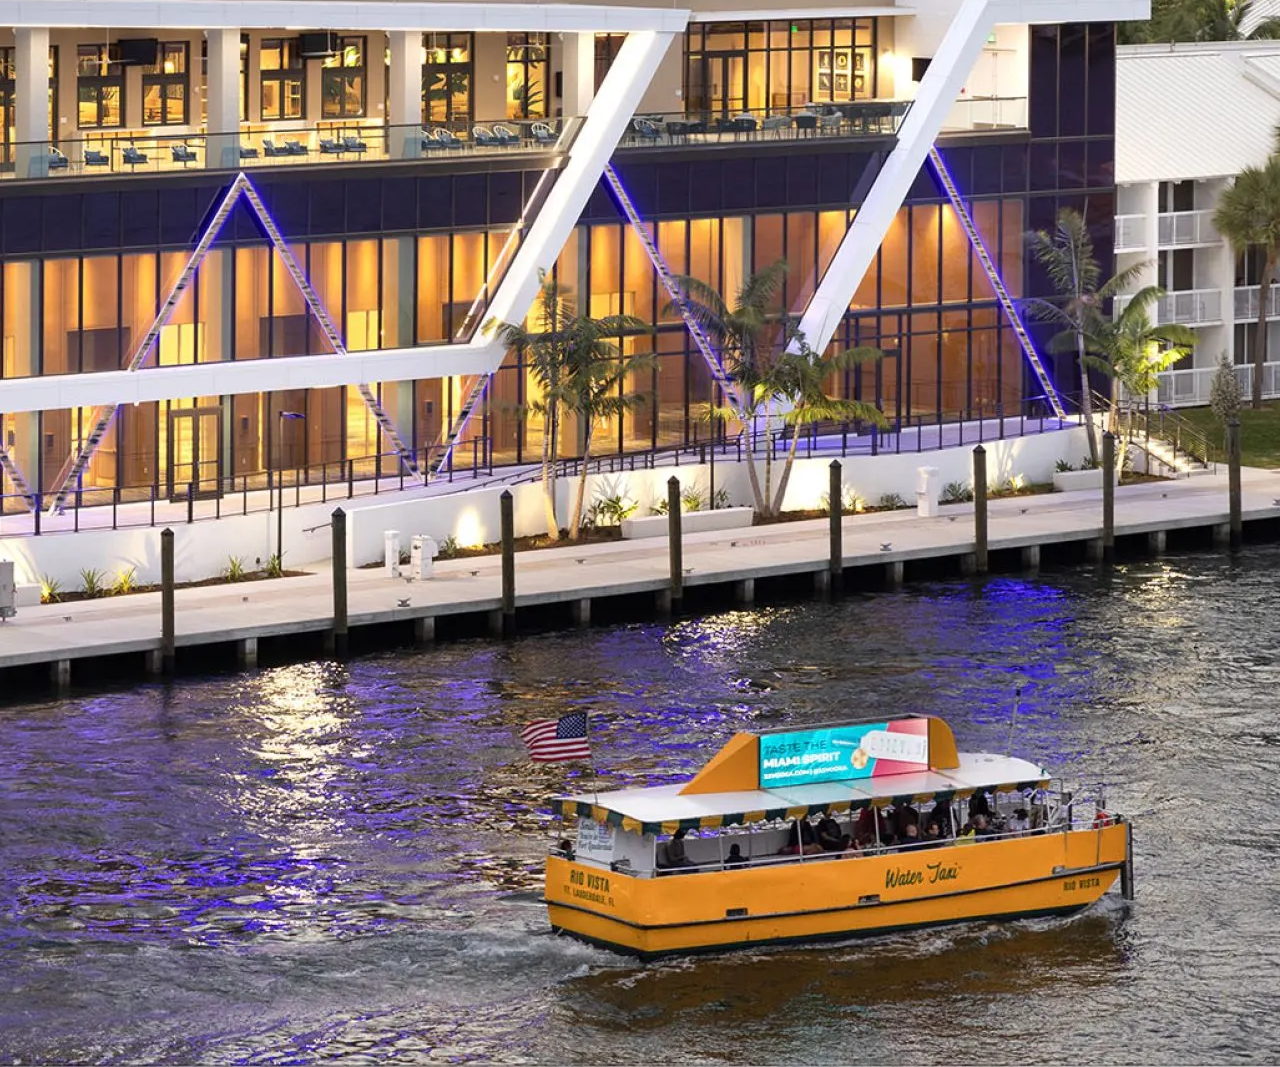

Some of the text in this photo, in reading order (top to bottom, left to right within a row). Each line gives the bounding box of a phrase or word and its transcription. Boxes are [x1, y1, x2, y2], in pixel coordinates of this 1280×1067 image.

[763, 742, 801, 756] TASTE
[803, 740, 827, 752] THE
[763, 751, 841, 769] MIAMI SPIRIT
[570, 869, 610, 893] RIO VISTA
[885, 861, 959, 888] Water Taxi
[1063, 878, 1100, 891] RIO VISTA
